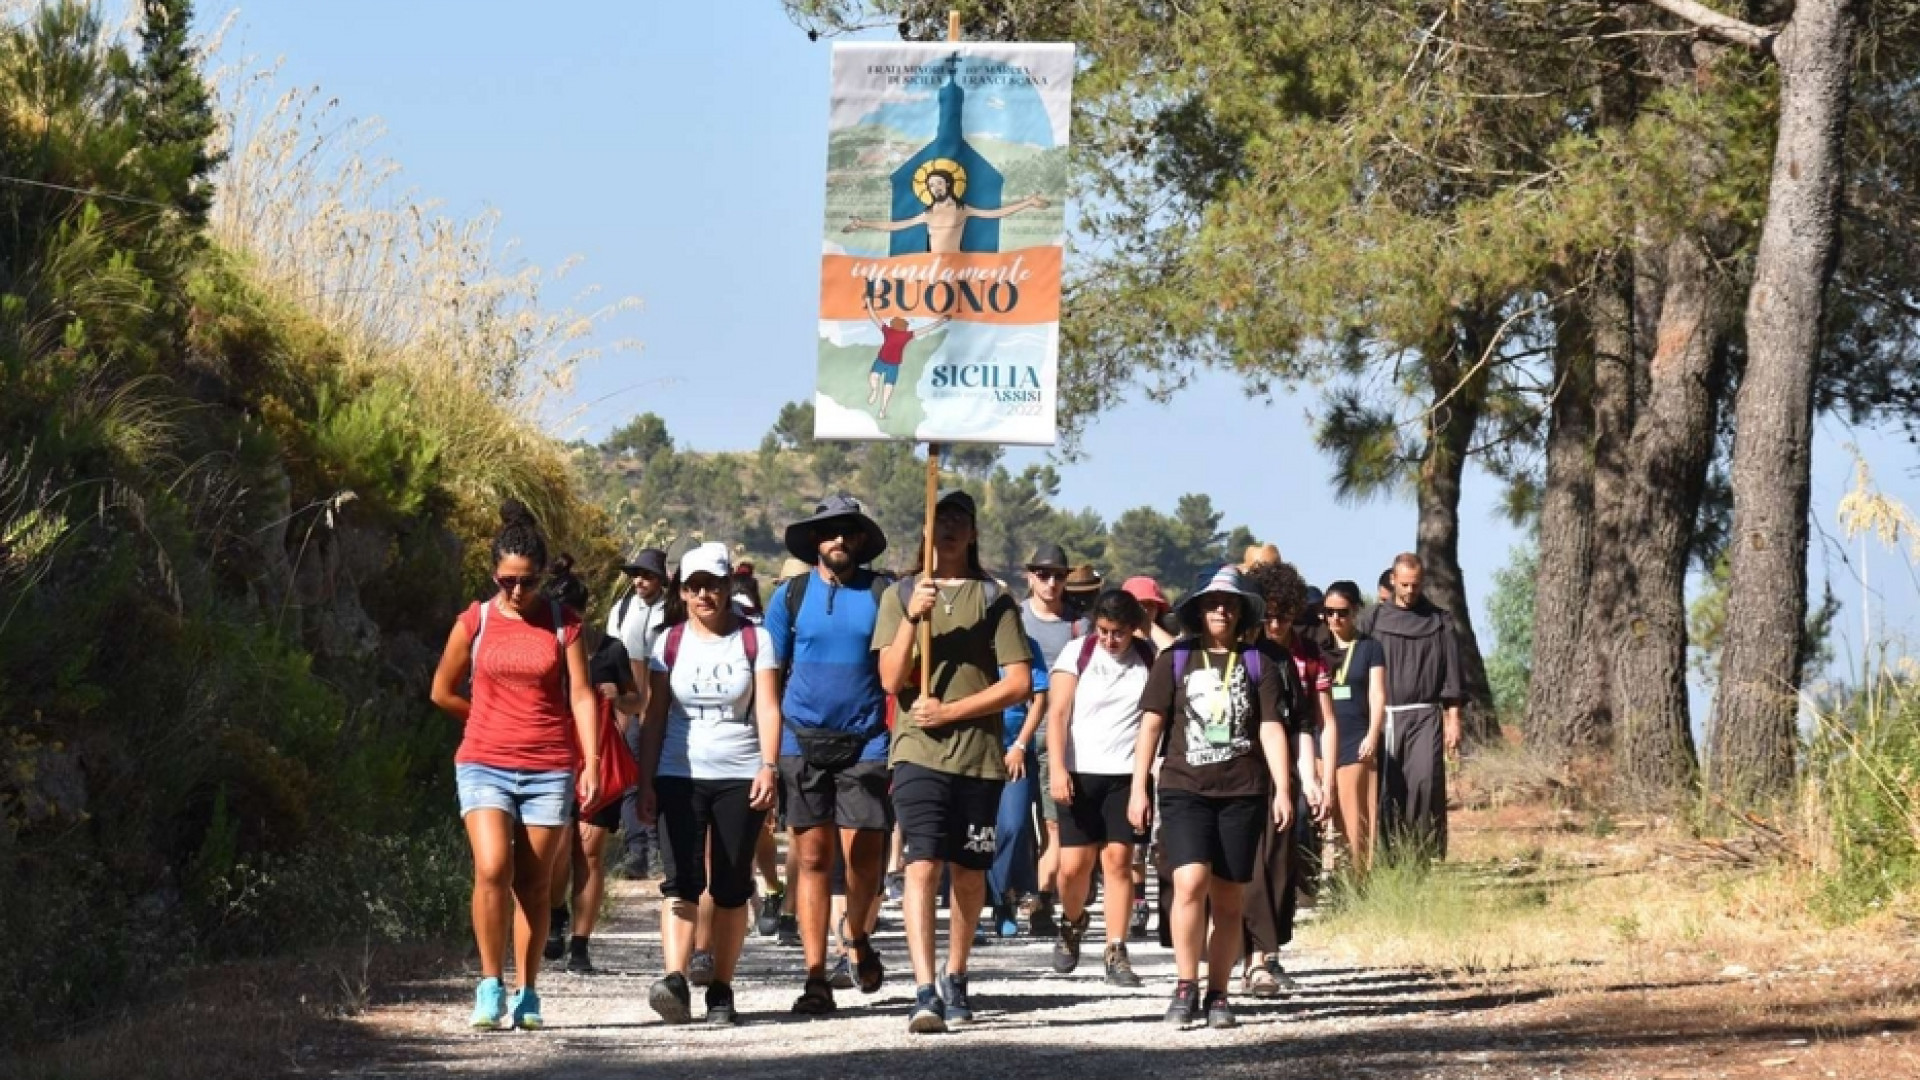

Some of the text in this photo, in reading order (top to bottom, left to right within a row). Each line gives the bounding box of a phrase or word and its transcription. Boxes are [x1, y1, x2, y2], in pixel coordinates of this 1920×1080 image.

[863, 276, 1019, 314] BUONO
[931, 364, 1041, 389] SICILIA
[993, 390, 1041, 402] ASSISI
[1007, 404, 1042, 416] 2022
